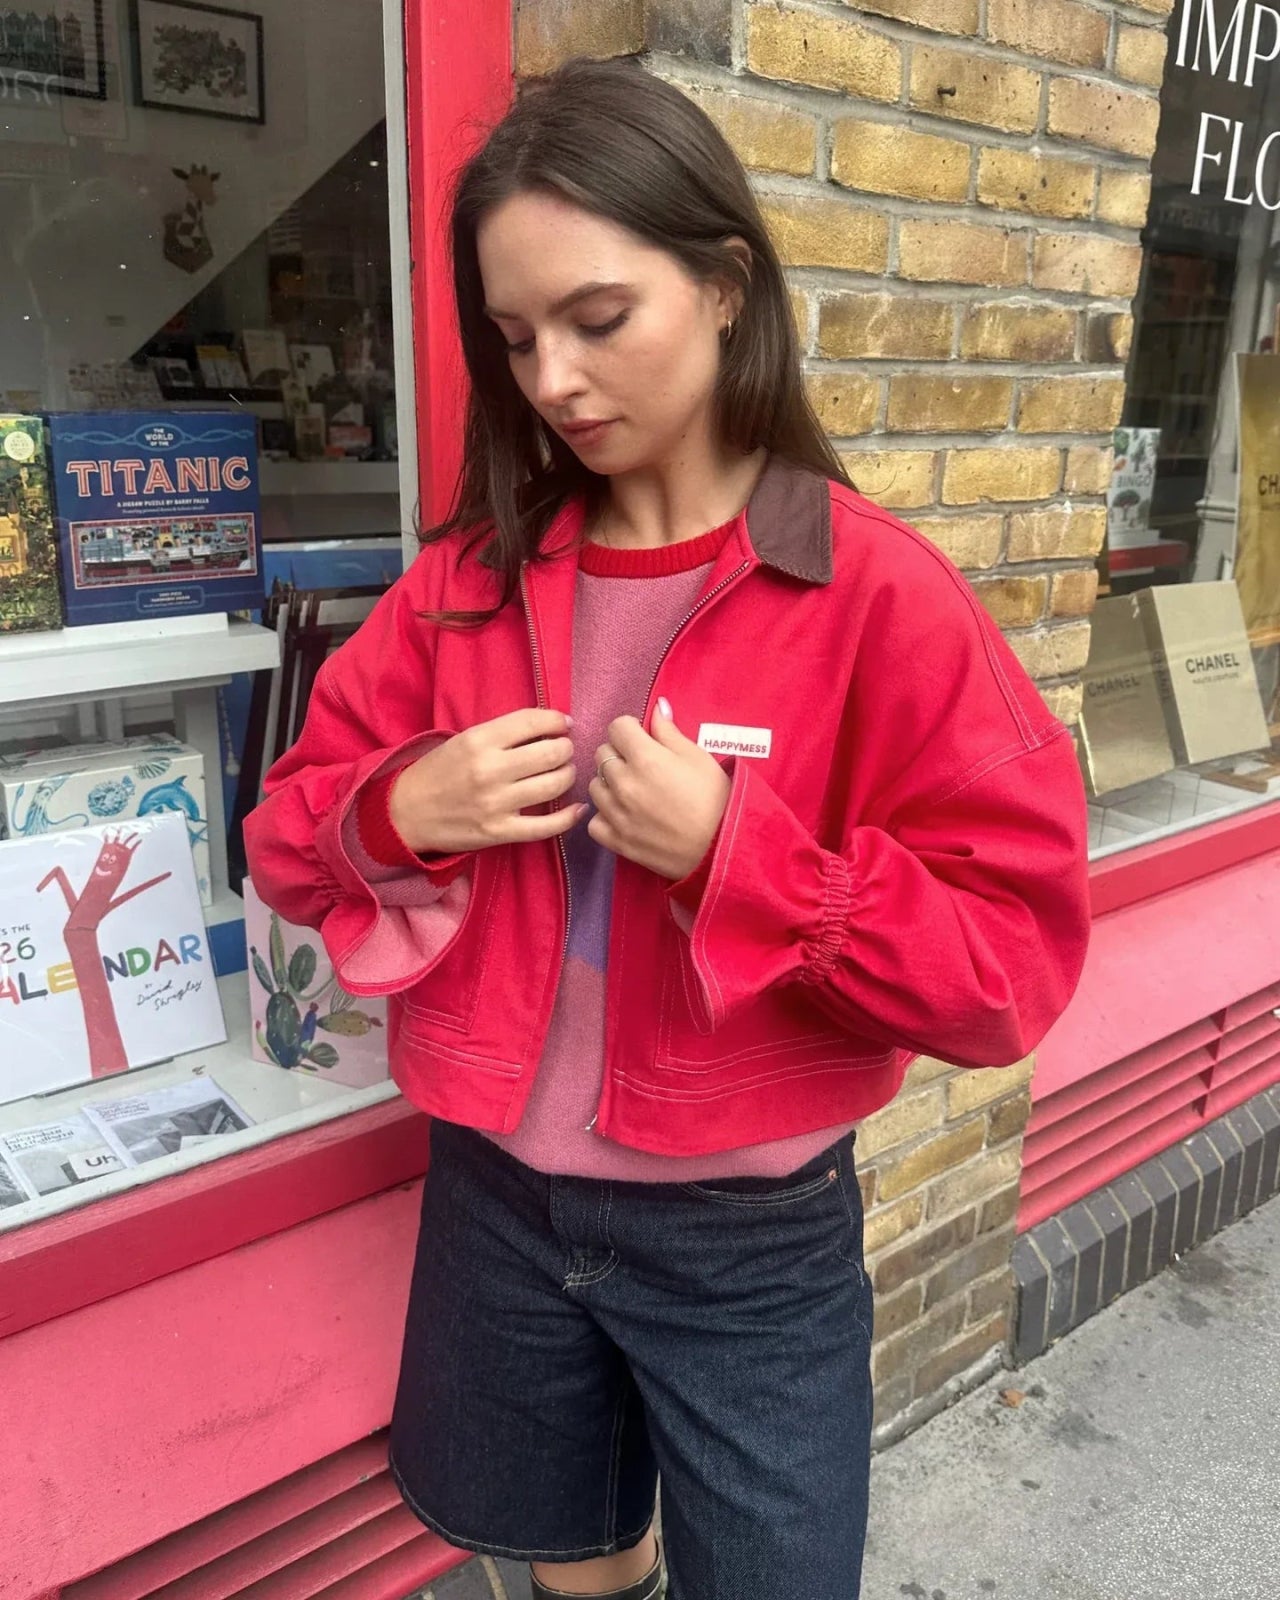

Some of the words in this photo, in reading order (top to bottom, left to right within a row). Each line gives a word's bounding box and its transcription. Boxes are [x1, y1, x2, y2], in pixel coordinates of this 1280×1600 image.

[1176, 0, 1280, 86] IMP
[144, 433, 174, 441] WORLD
[66, 457, 251, 497] TITANIC
[1117, 474, 1151, 487] BINGO
[1257, 474, 1280, 496] CH
[1185, 652, 1240, 674] CHANEL
[1087, 672, 1141, 698] CHANEL
[704, 739, 767, 754] HAPPYMESS
[11, 924, 30, 934] THE
